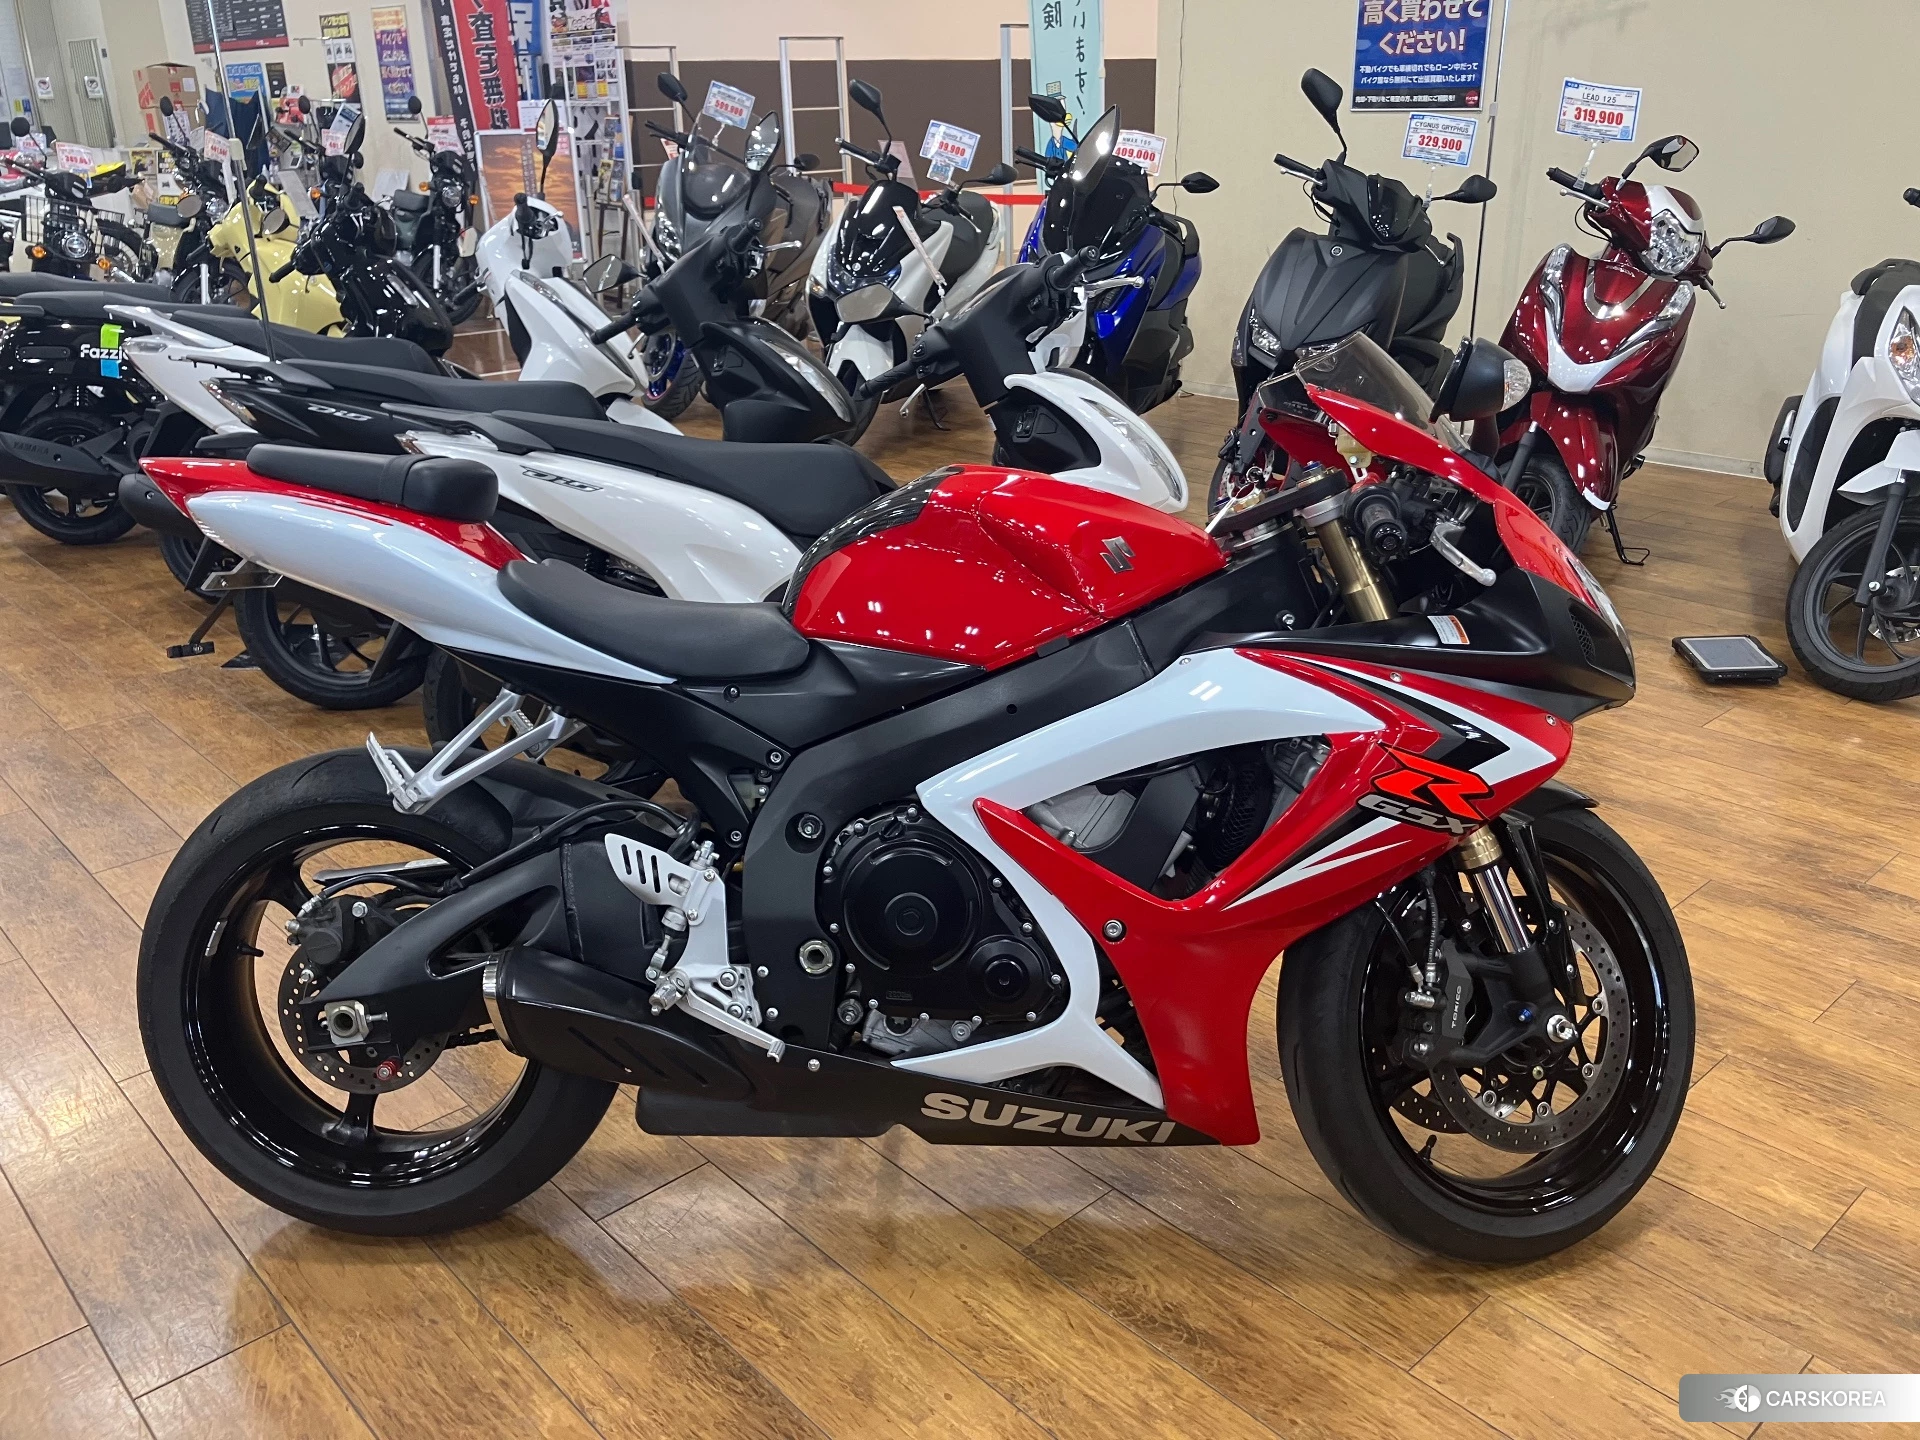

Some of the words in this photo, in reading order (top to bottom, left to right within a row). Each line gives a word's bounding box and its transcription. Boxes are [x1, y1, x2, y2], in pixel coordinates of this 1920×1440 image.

[1363, 0, 1483, 25] 高く買わせて
[1379, 28, 1466, 54] ください!
[1582, 92, 1600, 101] LEAD
[1603, 95, 1617, 103] 125
[1574, 107, 1624, 125] 319,900
[1414, 121, 1440, 130] CYGNUS
[1441, 123, 1469, 134] GRYPHUS
[938, 140, 966, 157] 99,900
[1418, 134, 1463, 151] 329,900
[1115, 147, 1156, 162] 409,000
[1374, 746, 1489, 821] R
[1358, 793, 1479, 834] GSX
[1451, 985, 1462, 1029] TOKICO
[920, 1092, 1176, 1144] SUZUKI
